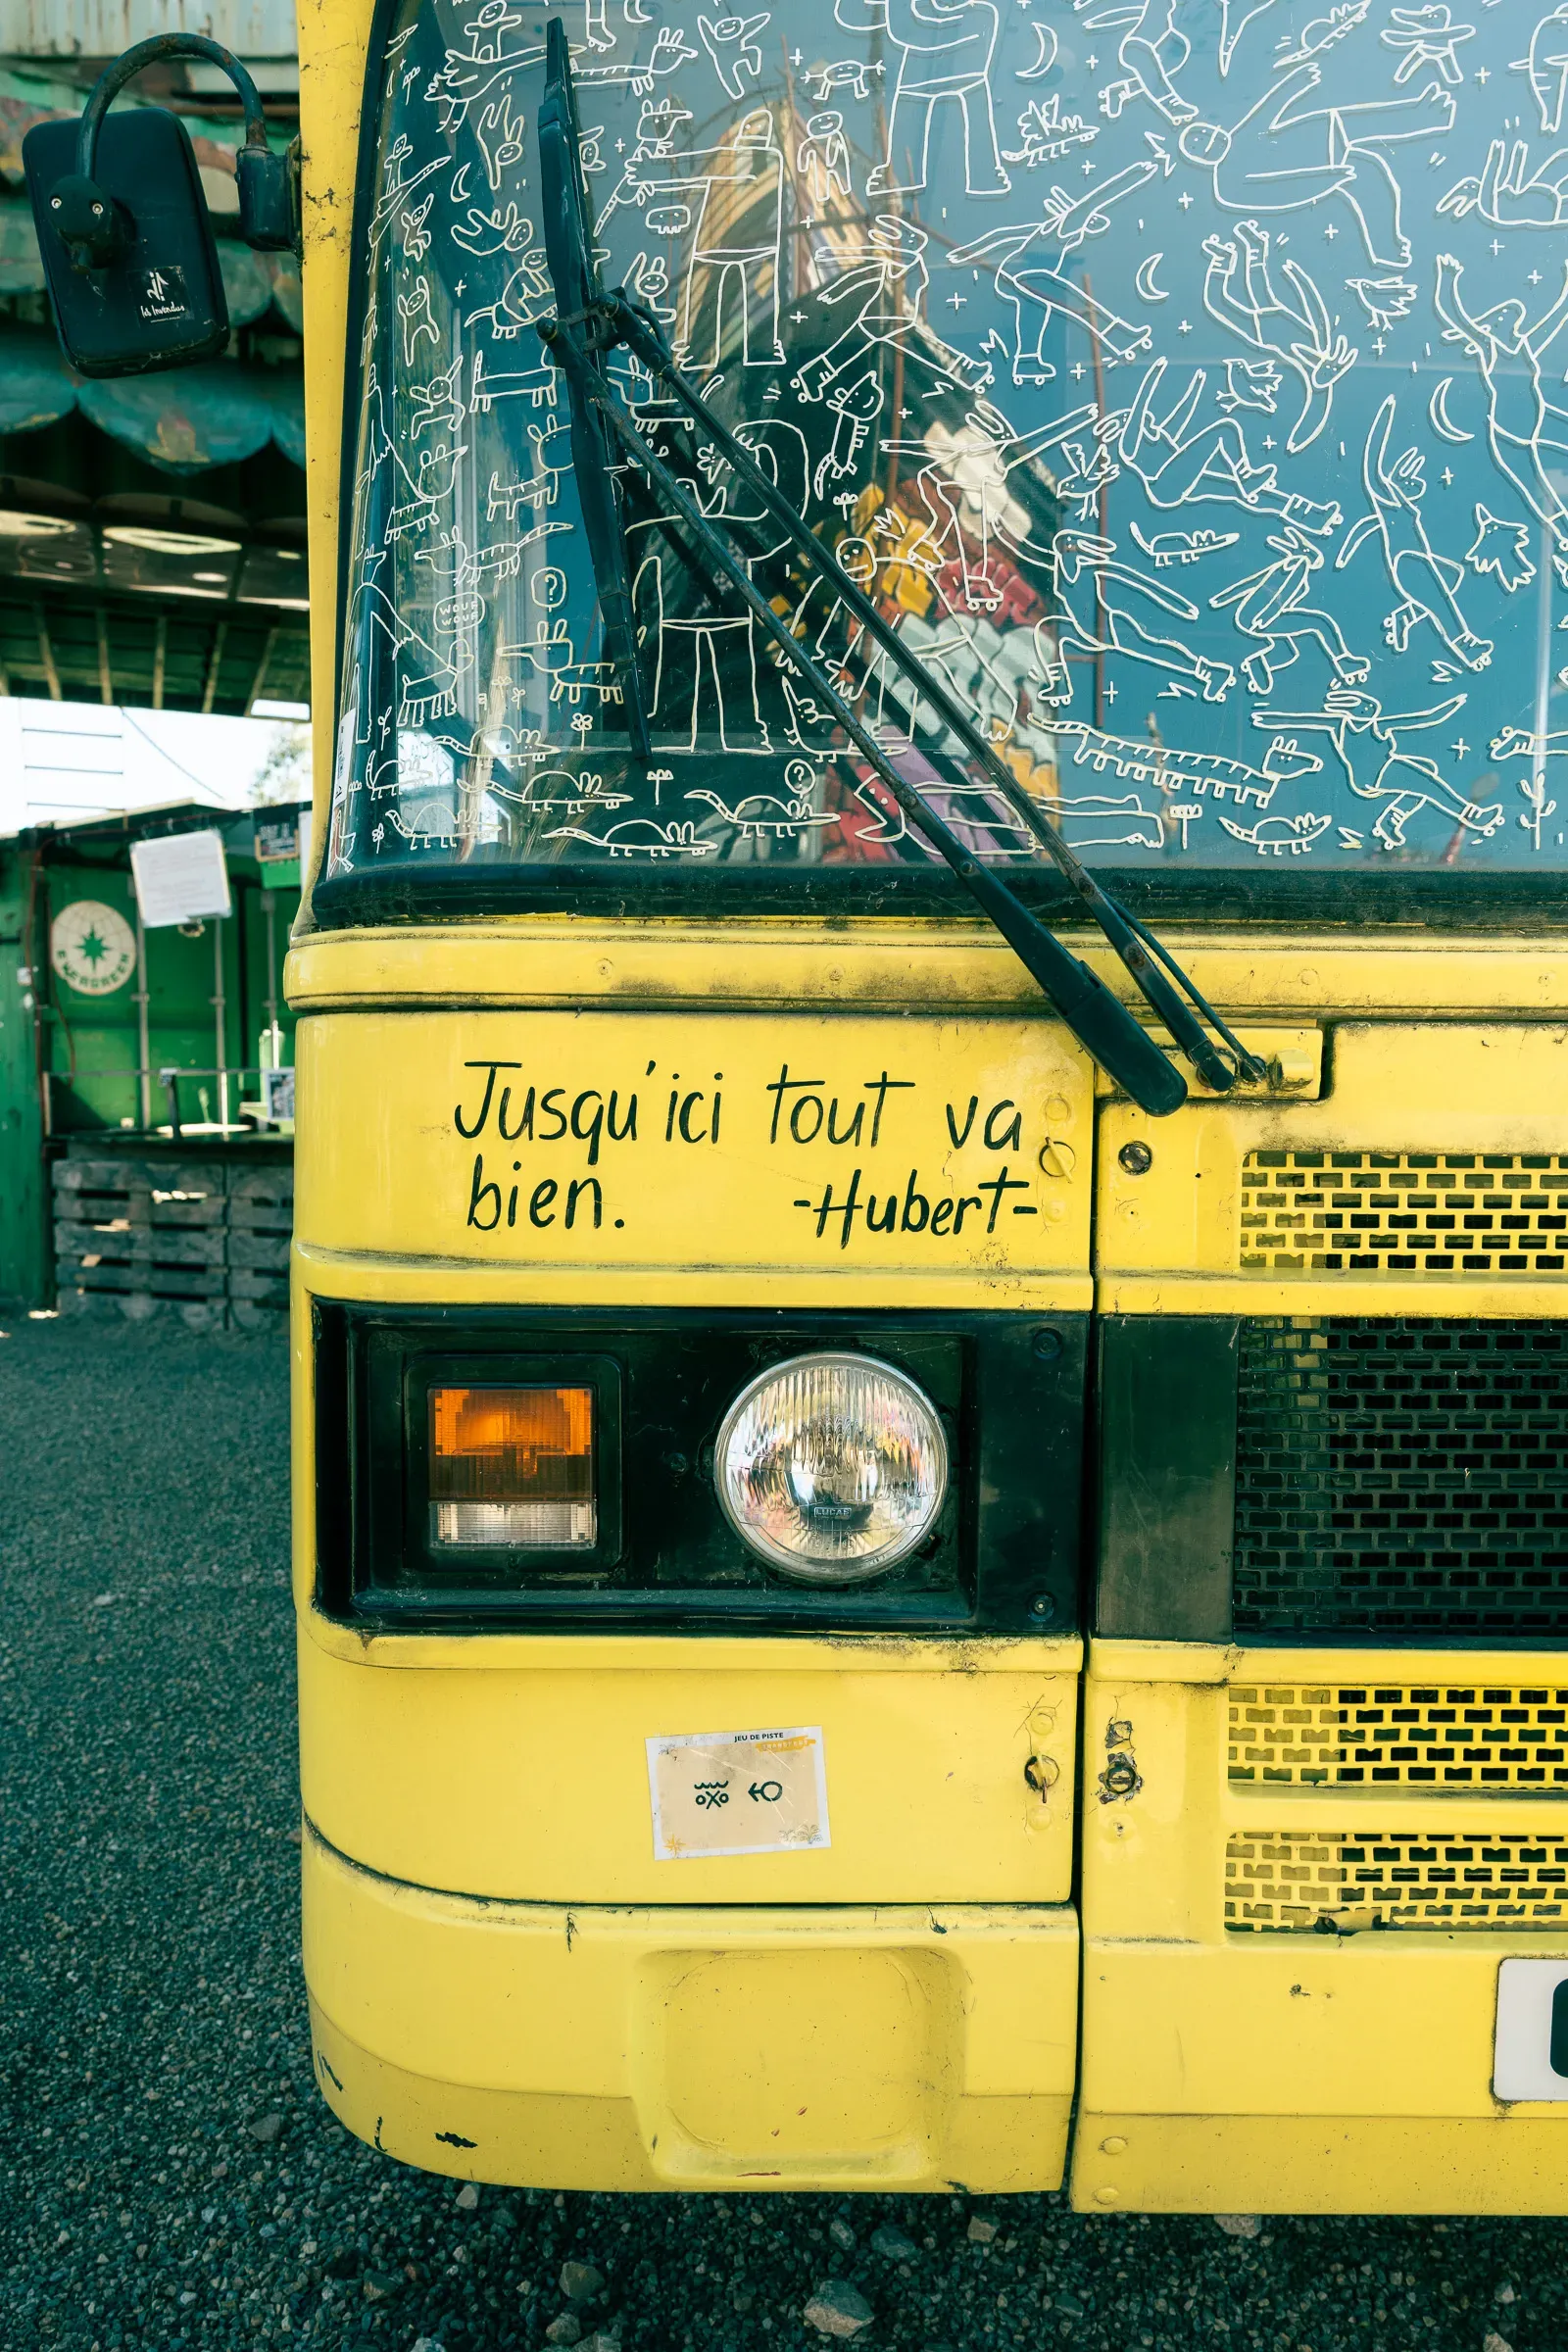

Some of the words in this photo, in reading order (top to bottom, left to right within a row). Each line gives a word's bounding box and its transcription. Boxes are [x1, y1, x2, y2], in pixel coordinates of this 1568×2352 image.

[544, 573, 558, 602] ?
[439, 601, 478, 615] WOUF
[793, 765, 805, 787] ?
[56, 949, 129, 988] EVERGREEN
[455, 1060, 723, 1165] Jusqu'ici
[766, 1064, 915, 1147] tout
[947, 1096, 1022, 1151] va
[467, 1153, 625, 1230] bien.
